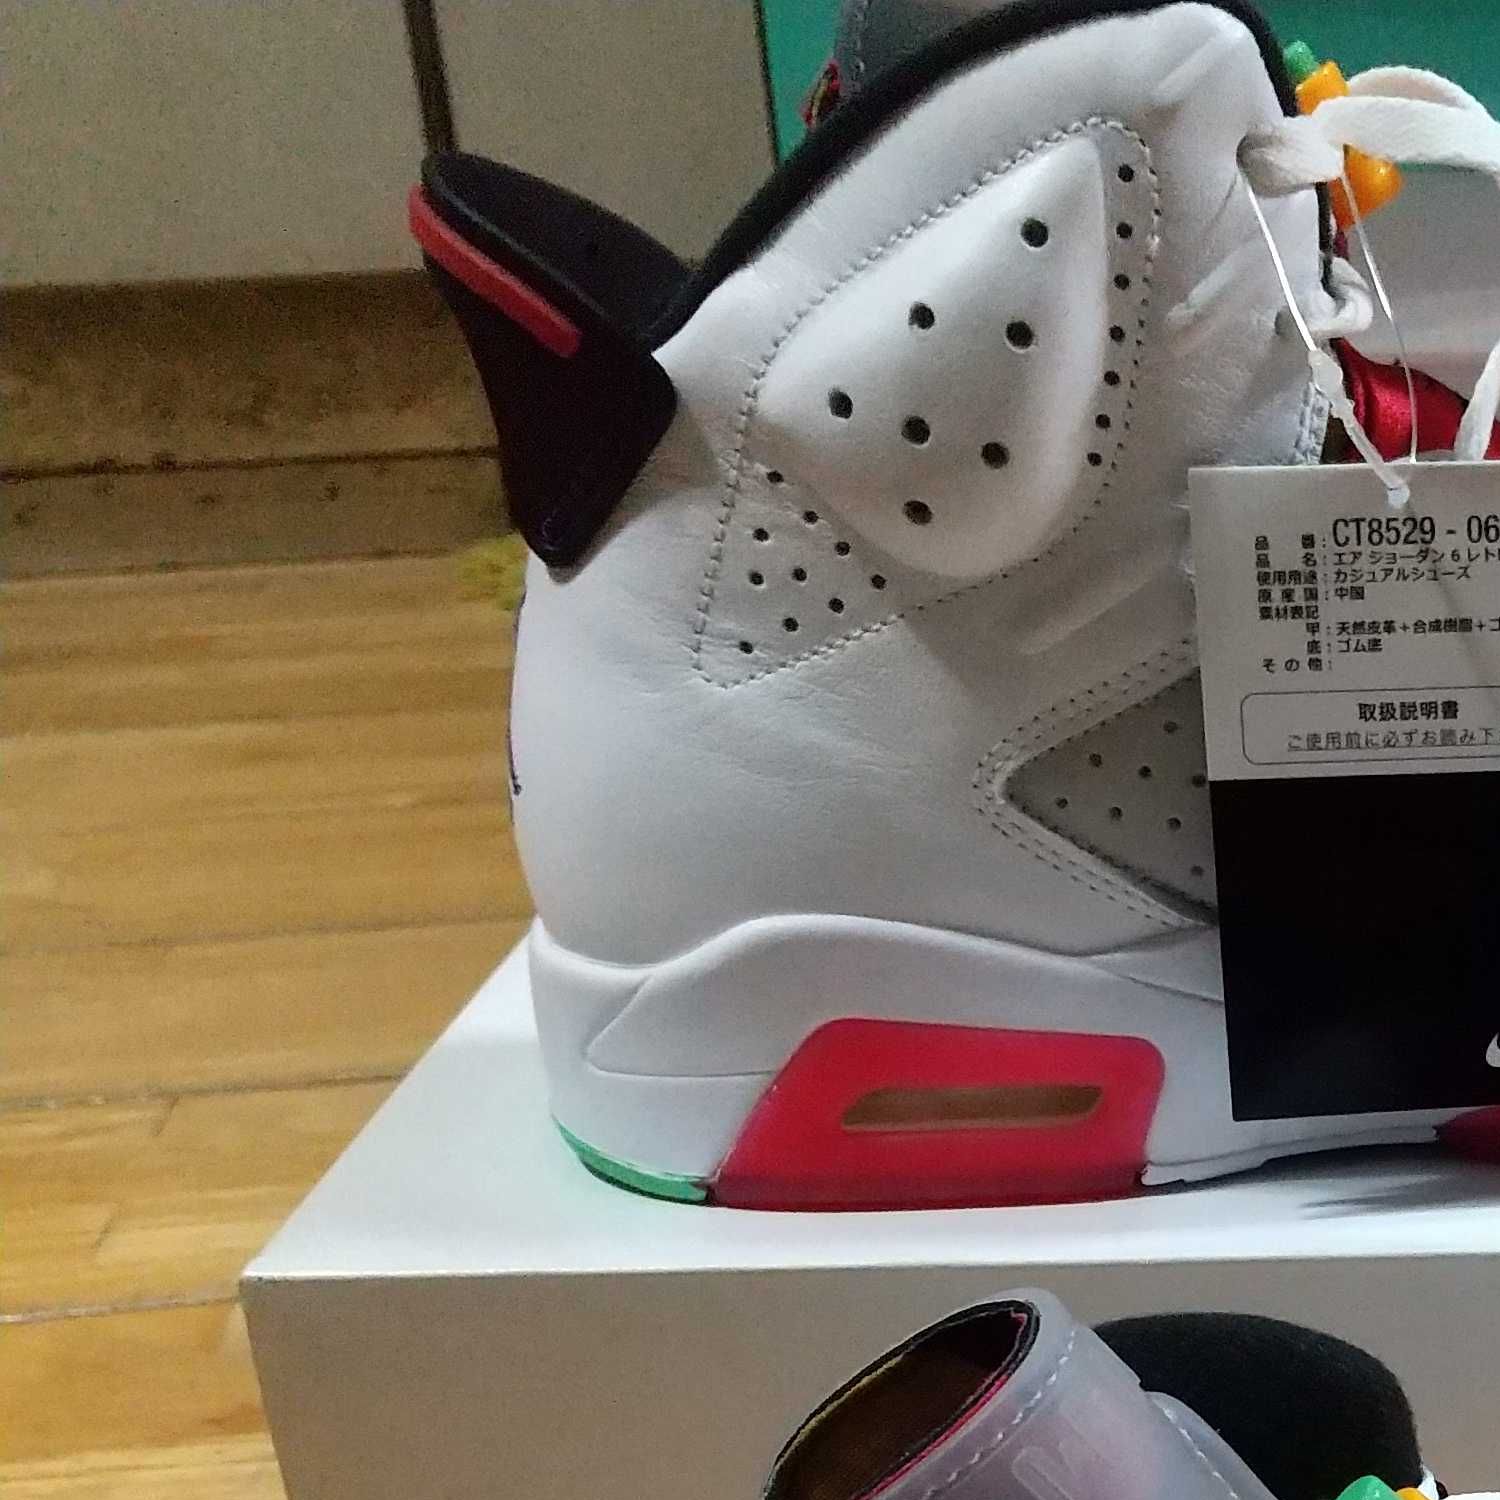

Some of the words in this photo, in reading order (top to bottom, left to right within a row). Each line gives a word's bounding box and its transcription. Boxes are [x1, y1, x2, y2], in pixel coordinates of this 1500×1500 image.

[1332, 516, 1436, 547] CT8529
[1358, 700, 1459, 721] 取扱説明書
